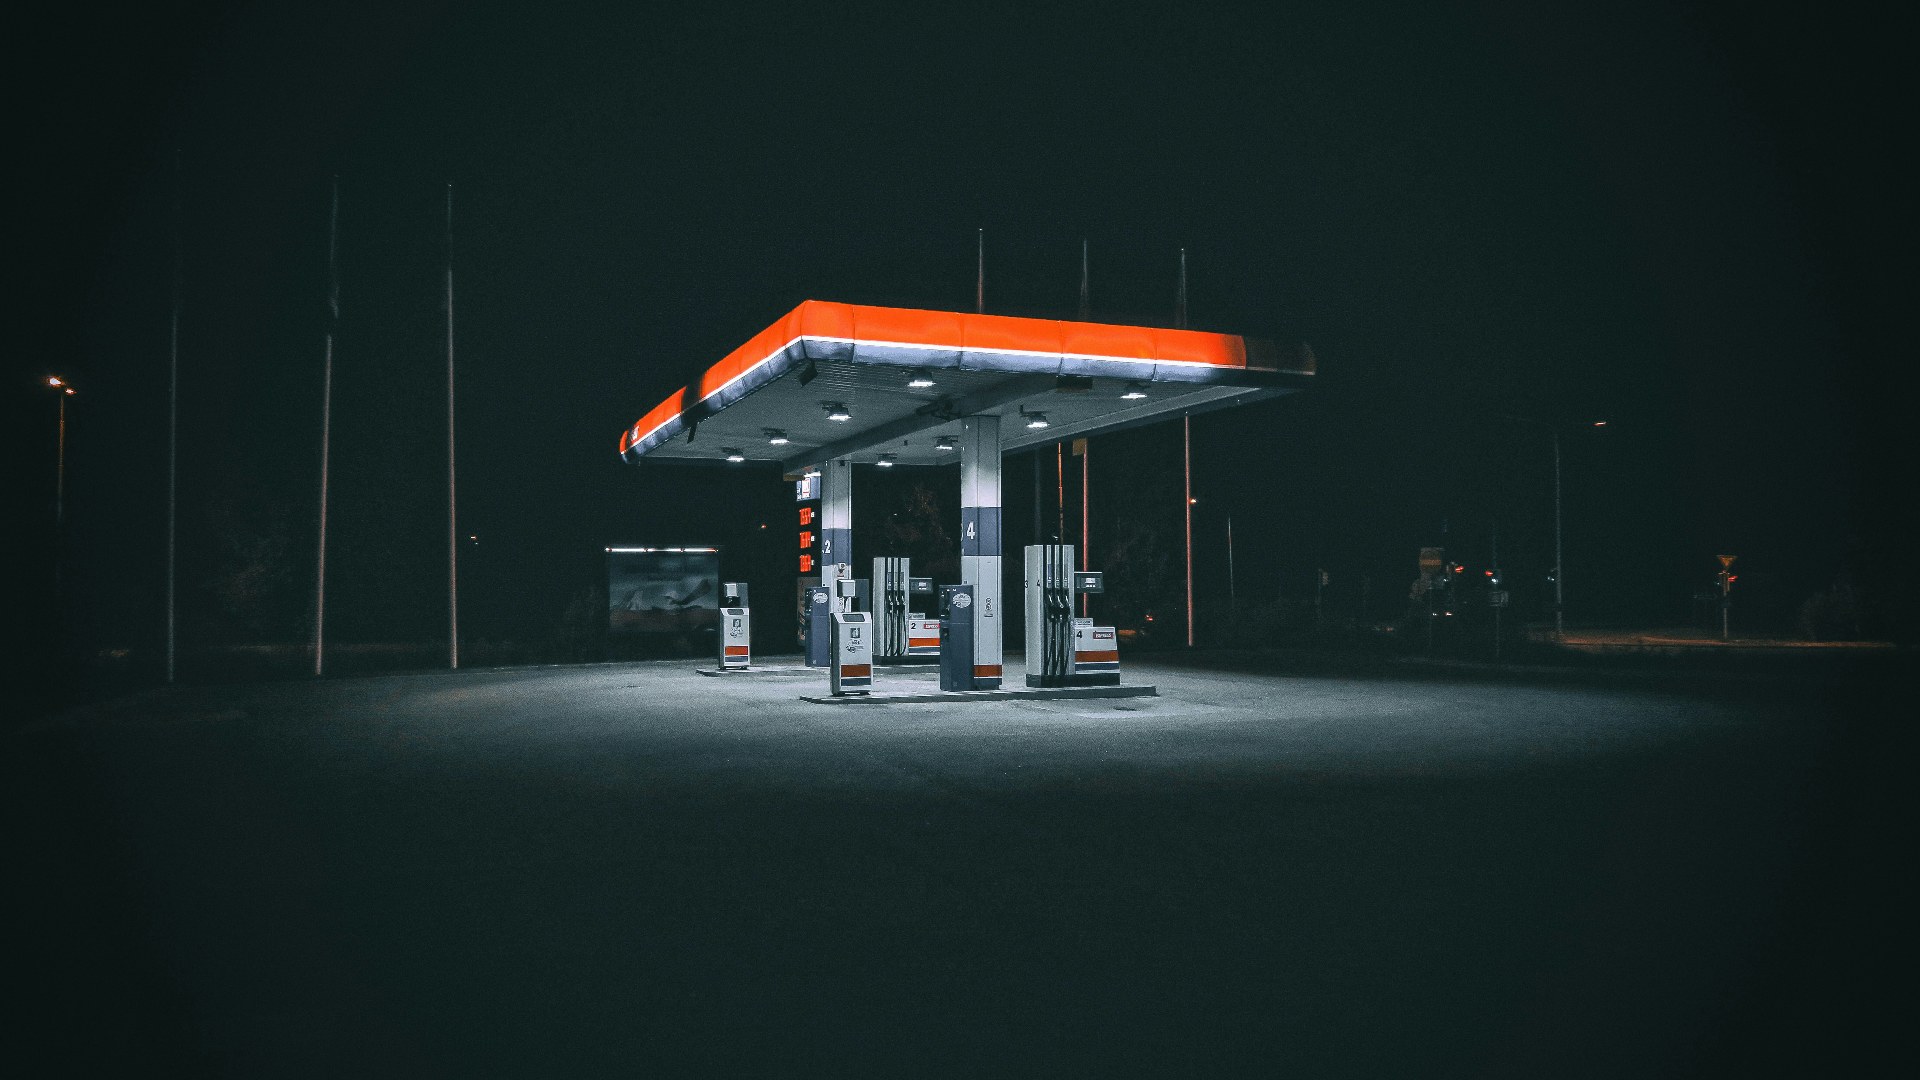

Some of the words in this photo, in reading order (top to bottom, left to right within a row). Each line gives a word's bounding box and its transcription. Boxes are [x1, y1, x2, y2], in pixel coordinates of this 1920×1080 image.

[967, 521, 975, 540] 4
[824, 539, 831, 554] 2
[1076, 630, 1083, 639] 4
